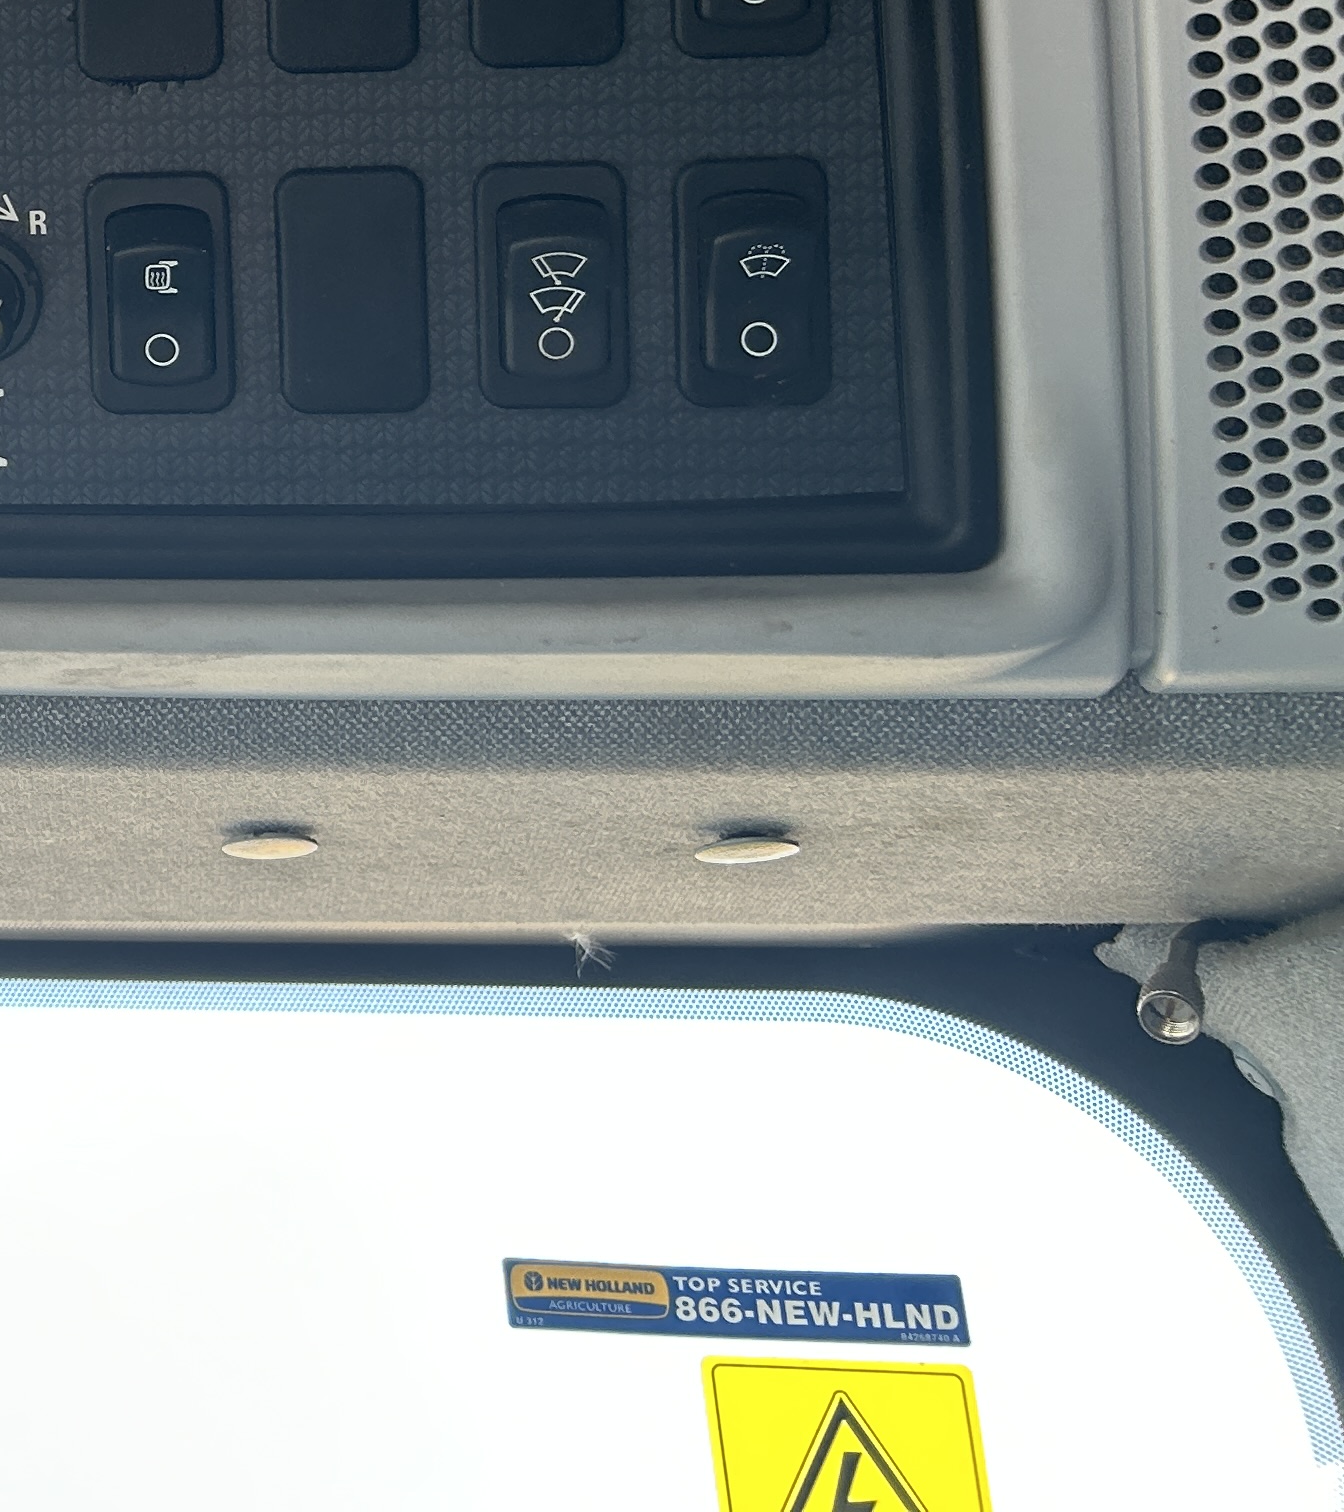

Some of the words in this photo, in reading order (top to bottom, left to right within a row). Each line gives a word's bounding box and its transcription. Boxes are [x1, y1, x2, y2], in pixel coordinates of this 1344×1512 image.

[29, 210, 47, 235] R
[546, 1276, 581, 1291] NEW
[585, 1279, 655, 1295] HOLLAND
[672, 1276, 722, 1293] TOP
[728, 1278, 822, 1296] SERVICE
[548, 1299, 633, 1314] AGRICULTURE
[675, 1296, 960, 1330] 866-NEW-HLND
